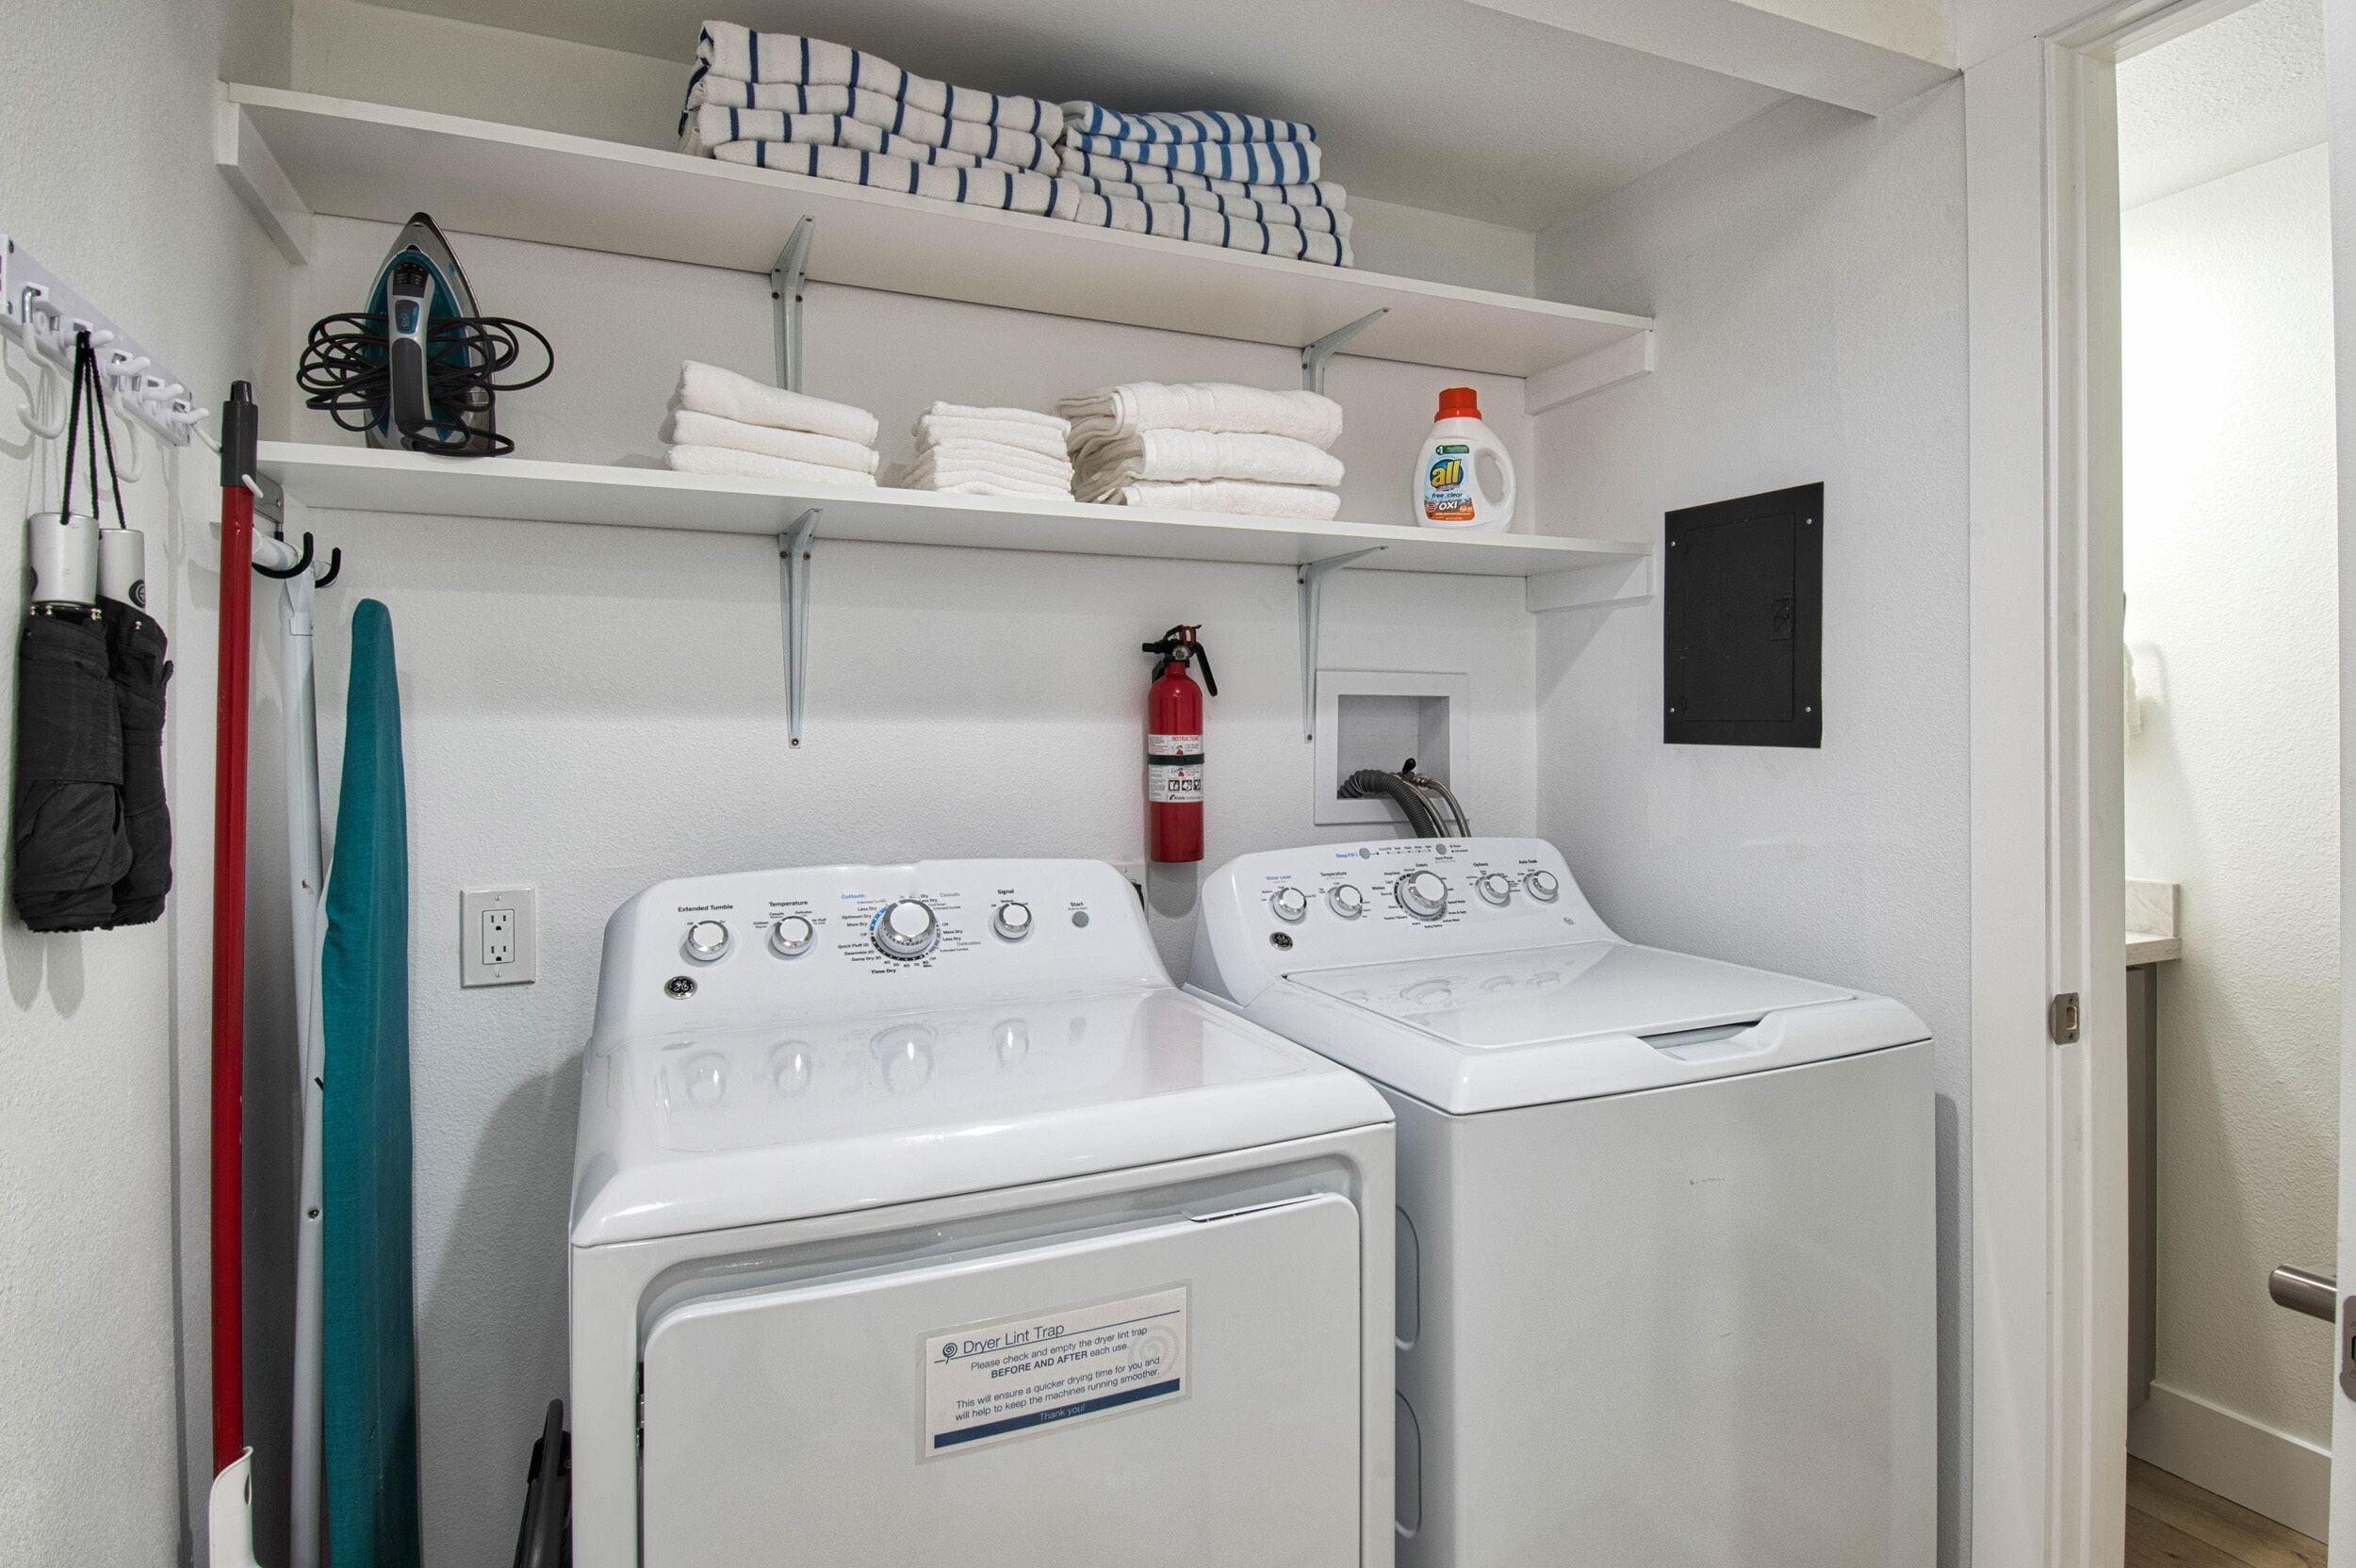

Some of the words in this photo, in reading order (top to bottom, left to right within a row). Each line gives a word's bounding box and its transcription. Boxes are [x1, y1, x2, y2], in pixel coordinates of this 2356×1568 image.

[1432, 459, 1461, 487] all
[1439, 501, 1458, 511] OXI
[769, 899, 808, 907] Temperature
[964, 1337, 1000, 1354] Dryer
[1005, 1330, 1030, 1345] Lint
[1034, 1325, 1064, 1339] Trap
[971, 1358, 1000, 1371] Please
[1003, 1352, 1029, 1364] check
[1031, 1348, 1048, 1359] and
[1050, 1343, 1077, 1355] empty
[1079, 1339, 1092, 1348] the
[1095, 1333, 1115, 1346] dryer
[1118, 1331, 1129, 1340] lint
[1131, 1327, 1147, 1337] trap
[991, 1363, 1031, 1379] BEFORE
[1034, 1358, 1054, 1370] AND
[1057, 1350, 1088, 1364] AFTER
[1090, 1346, 1110, 1357] each
[1113, 1343, 1129, 1353] use.
[955, 1411, 970, 1421] will
[972, 1407, 991, 1418] help
[994, 1405, 1003, 1413] to
[1005, 1400, 1027, 1410] keep
[1030, 1396, 1043, 1405] the
[1045, 1386, 1085, 1401] machines
[1088, 1378, 1118, 1392] running
[1120, 1369, 1160, 1384] smoother.
[956, 1398, 975, 1409] This
[977, 1395, 991, 1405] will
[994, 1388, 1023, 1401] ensure
[1034, 1379, 1065, 1393] quicker
[1067, 1372, 1093, 1386] drying
[1096, 1368, 1113, 1379] time
[1115, 1364, 1126, 1374] for
[1128, 1362, 1143, 1372] you
[1145, 1356, 1160, 1367] and
[1039, 1408, 1066, 1421] Thank
[1067, 1404, 1086, 1416] you!
